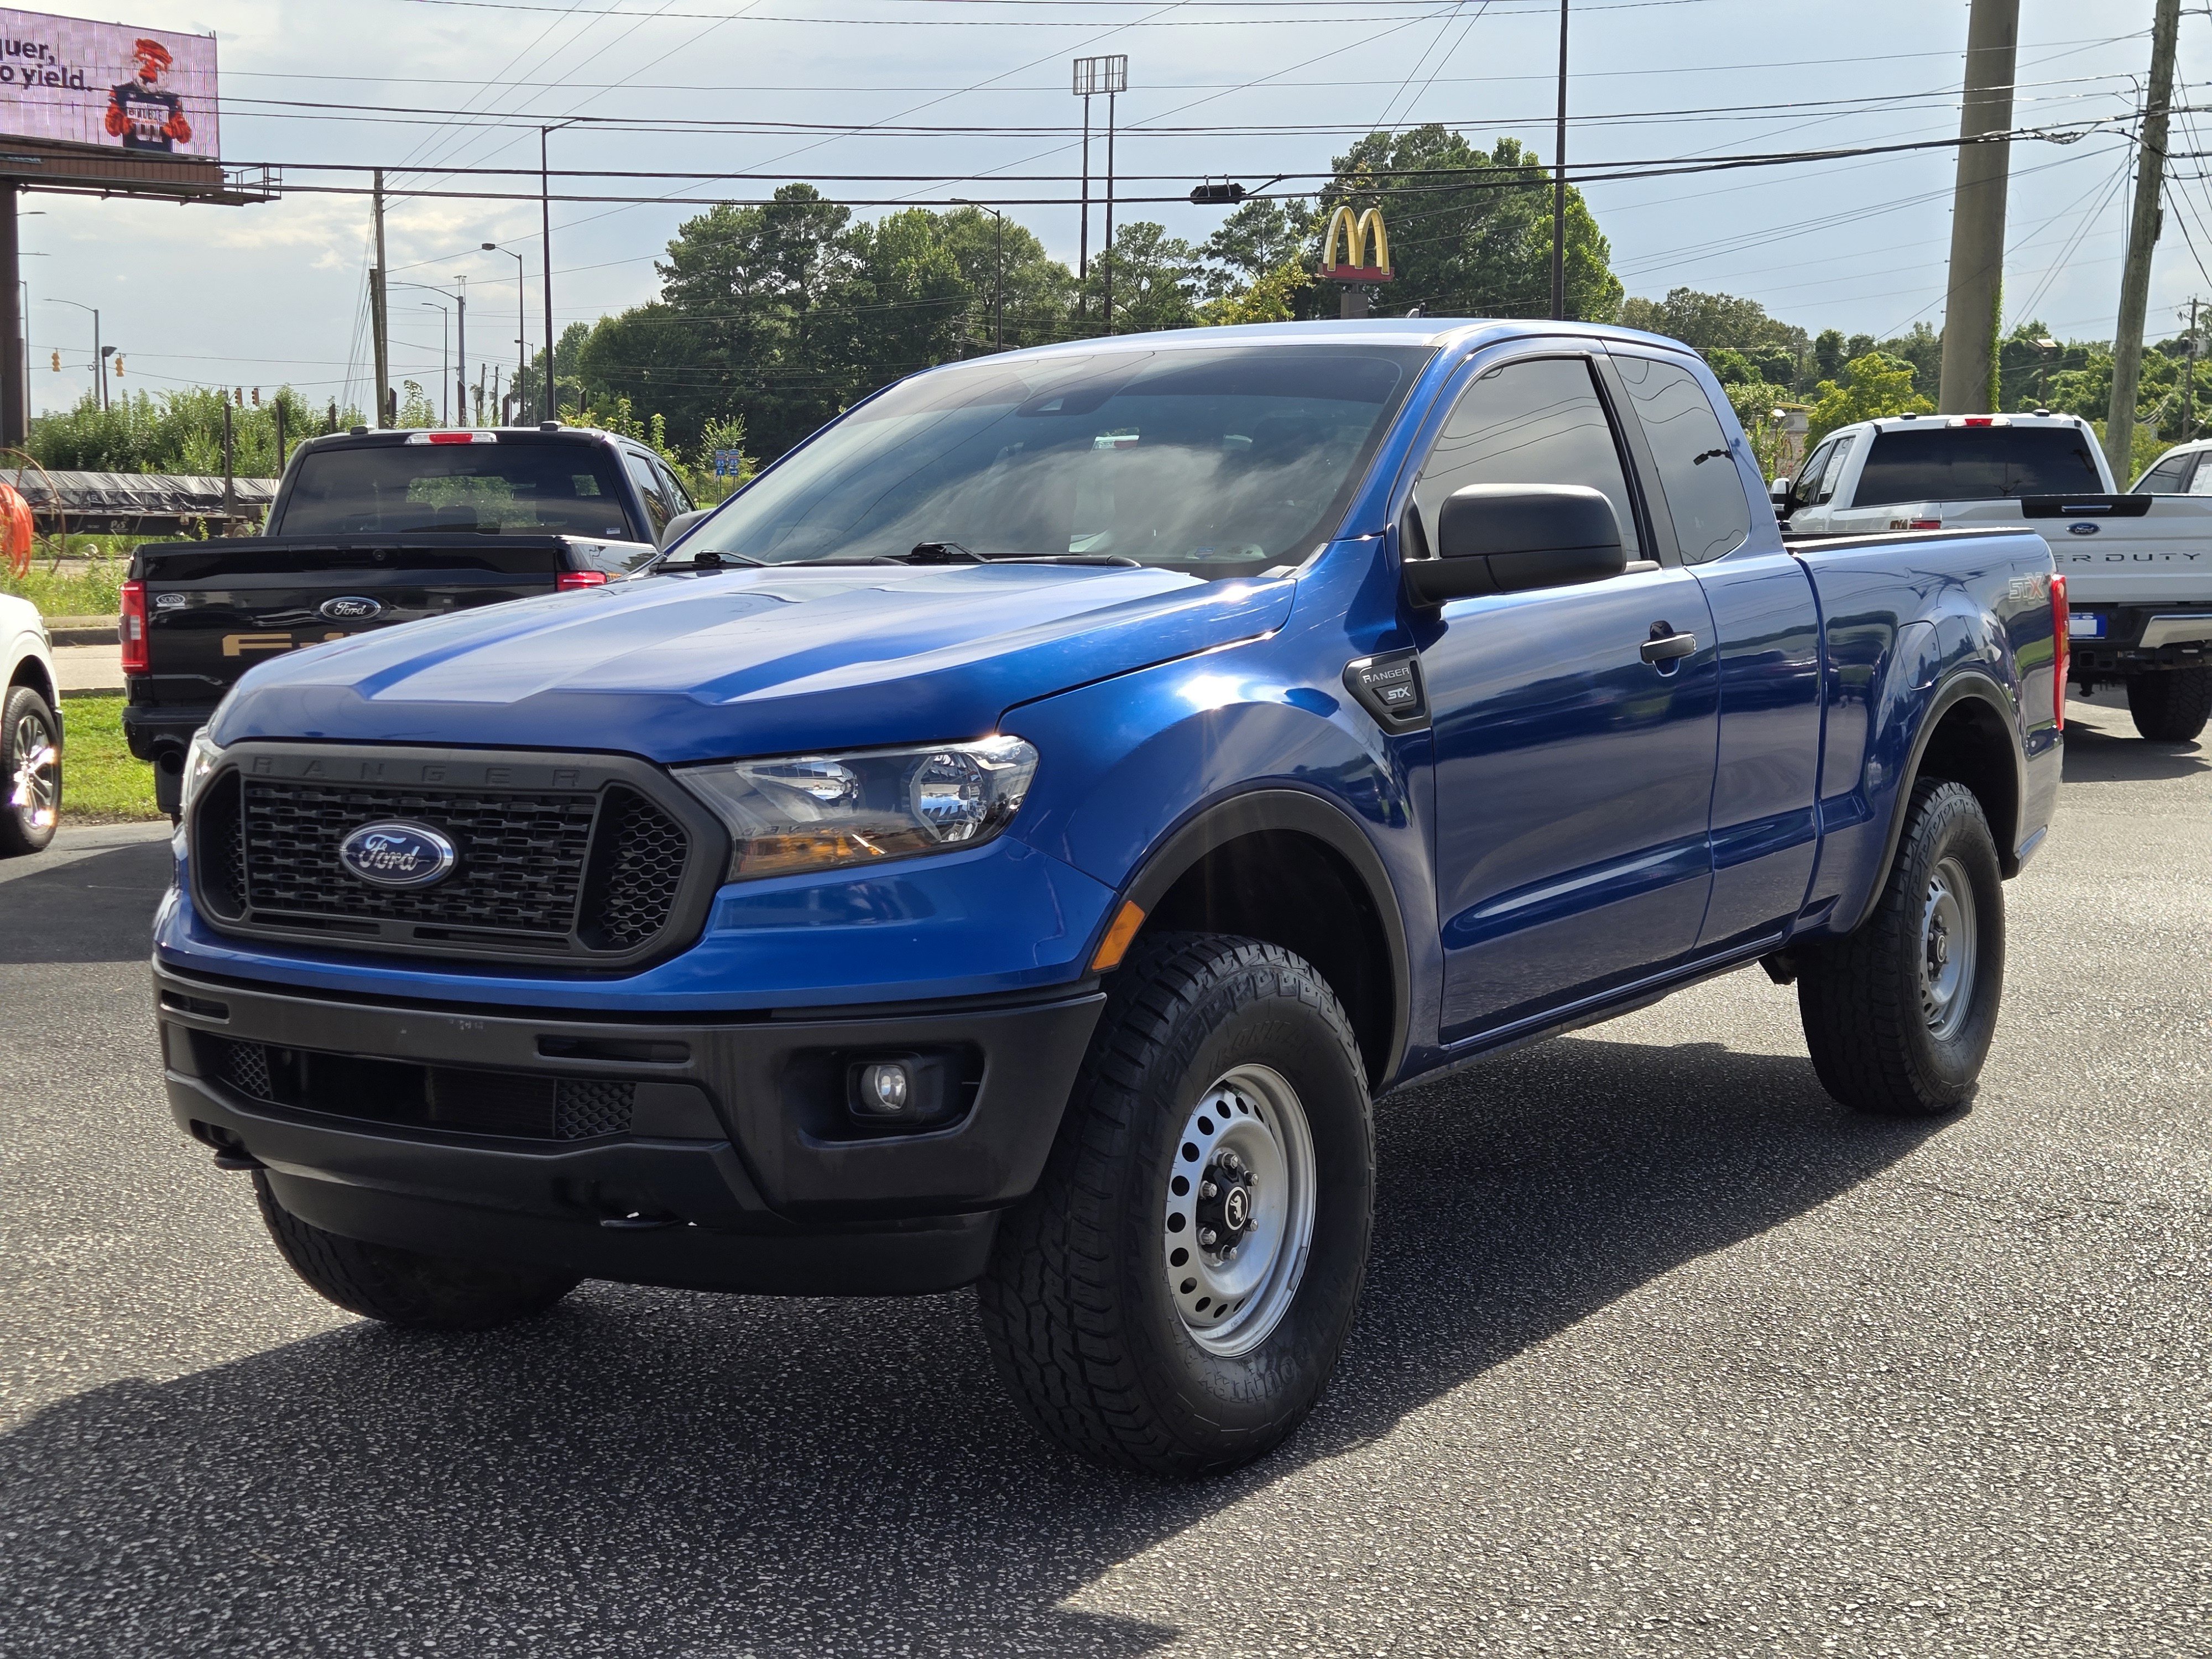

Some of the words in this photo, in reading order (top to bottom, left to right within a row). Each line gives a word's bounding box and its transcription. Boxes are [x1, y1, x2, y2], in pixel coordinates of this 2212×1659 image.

[0, 39, 55, 65] uer,
[21, 64, 92, 92] yield.
[2105, 553, 2201, 562] DUTY
[2008, 572, 2046, 604] STX
[334, 602, 366, 615] Ford
[1362, 667, 1410, 684] RANGER
[1387, 686, 1411, 701] STX
[252, 757, 581, 787] RANGER
[358, 834, 427, 872] Ford
